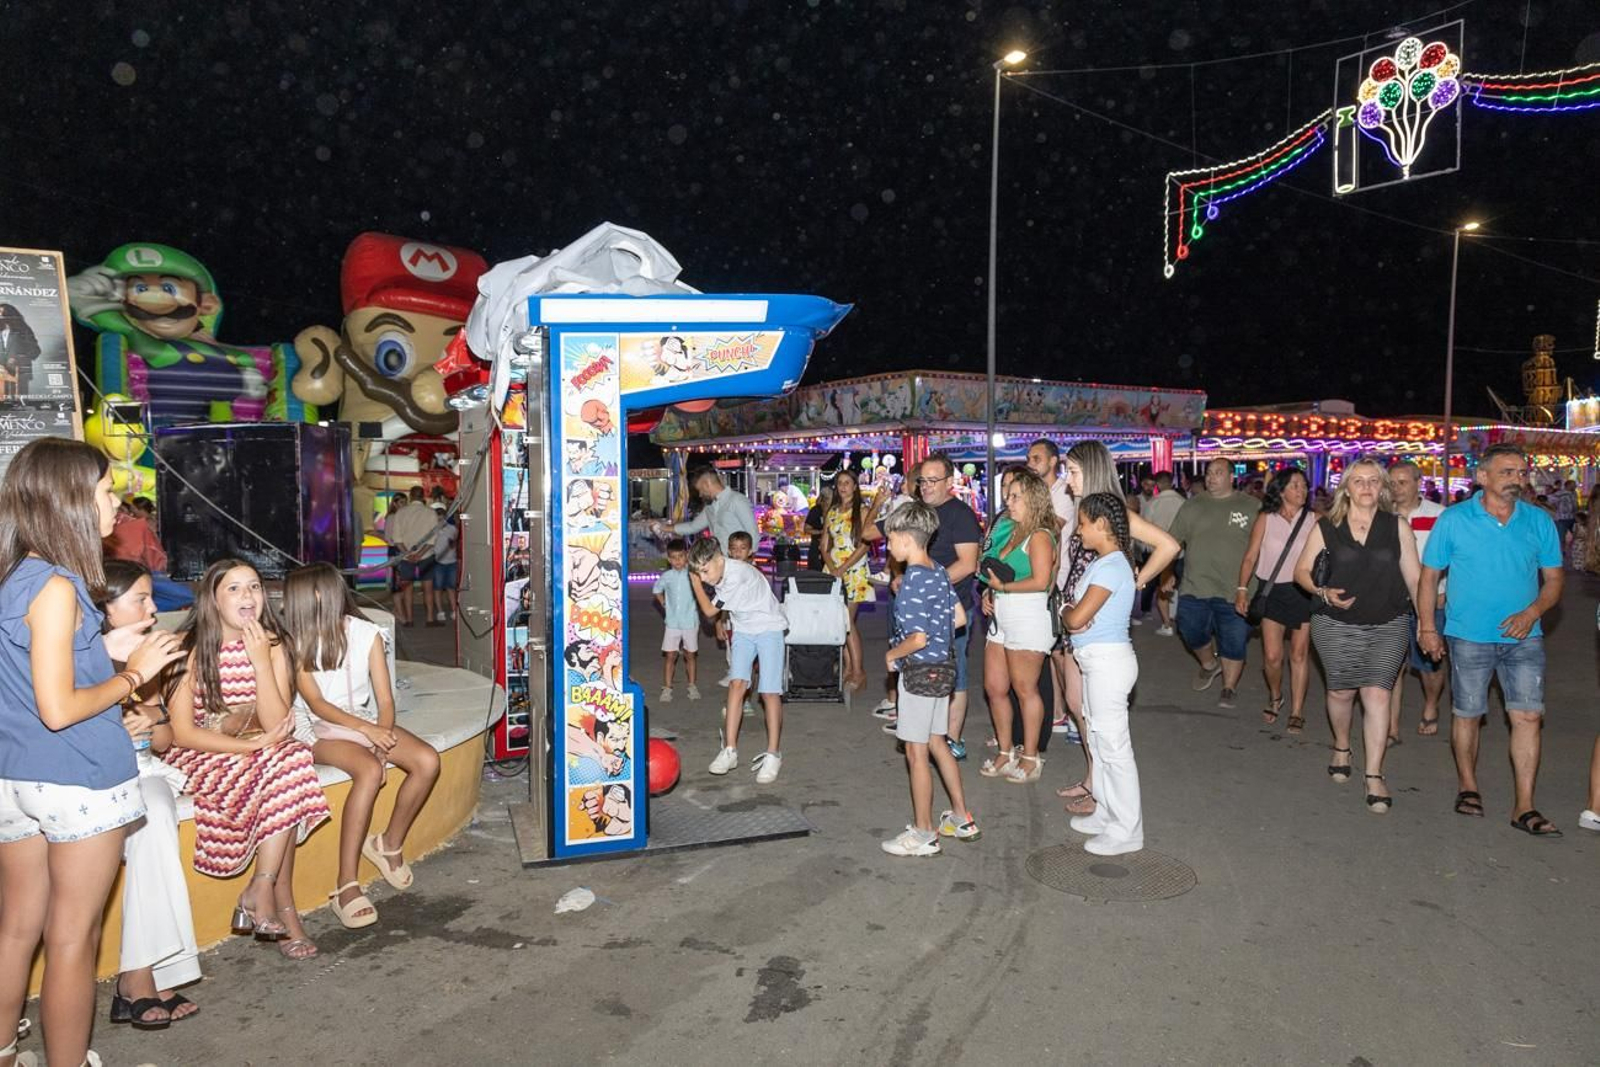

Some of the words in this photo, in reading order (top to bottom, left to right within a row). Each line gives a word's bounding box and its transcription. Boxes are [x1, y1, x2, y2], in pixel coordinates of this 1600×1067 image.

[134, 249, 156, 263] L
[408, 248, 451, 273] M
[571, 686, 634, 725] BAAAM!
